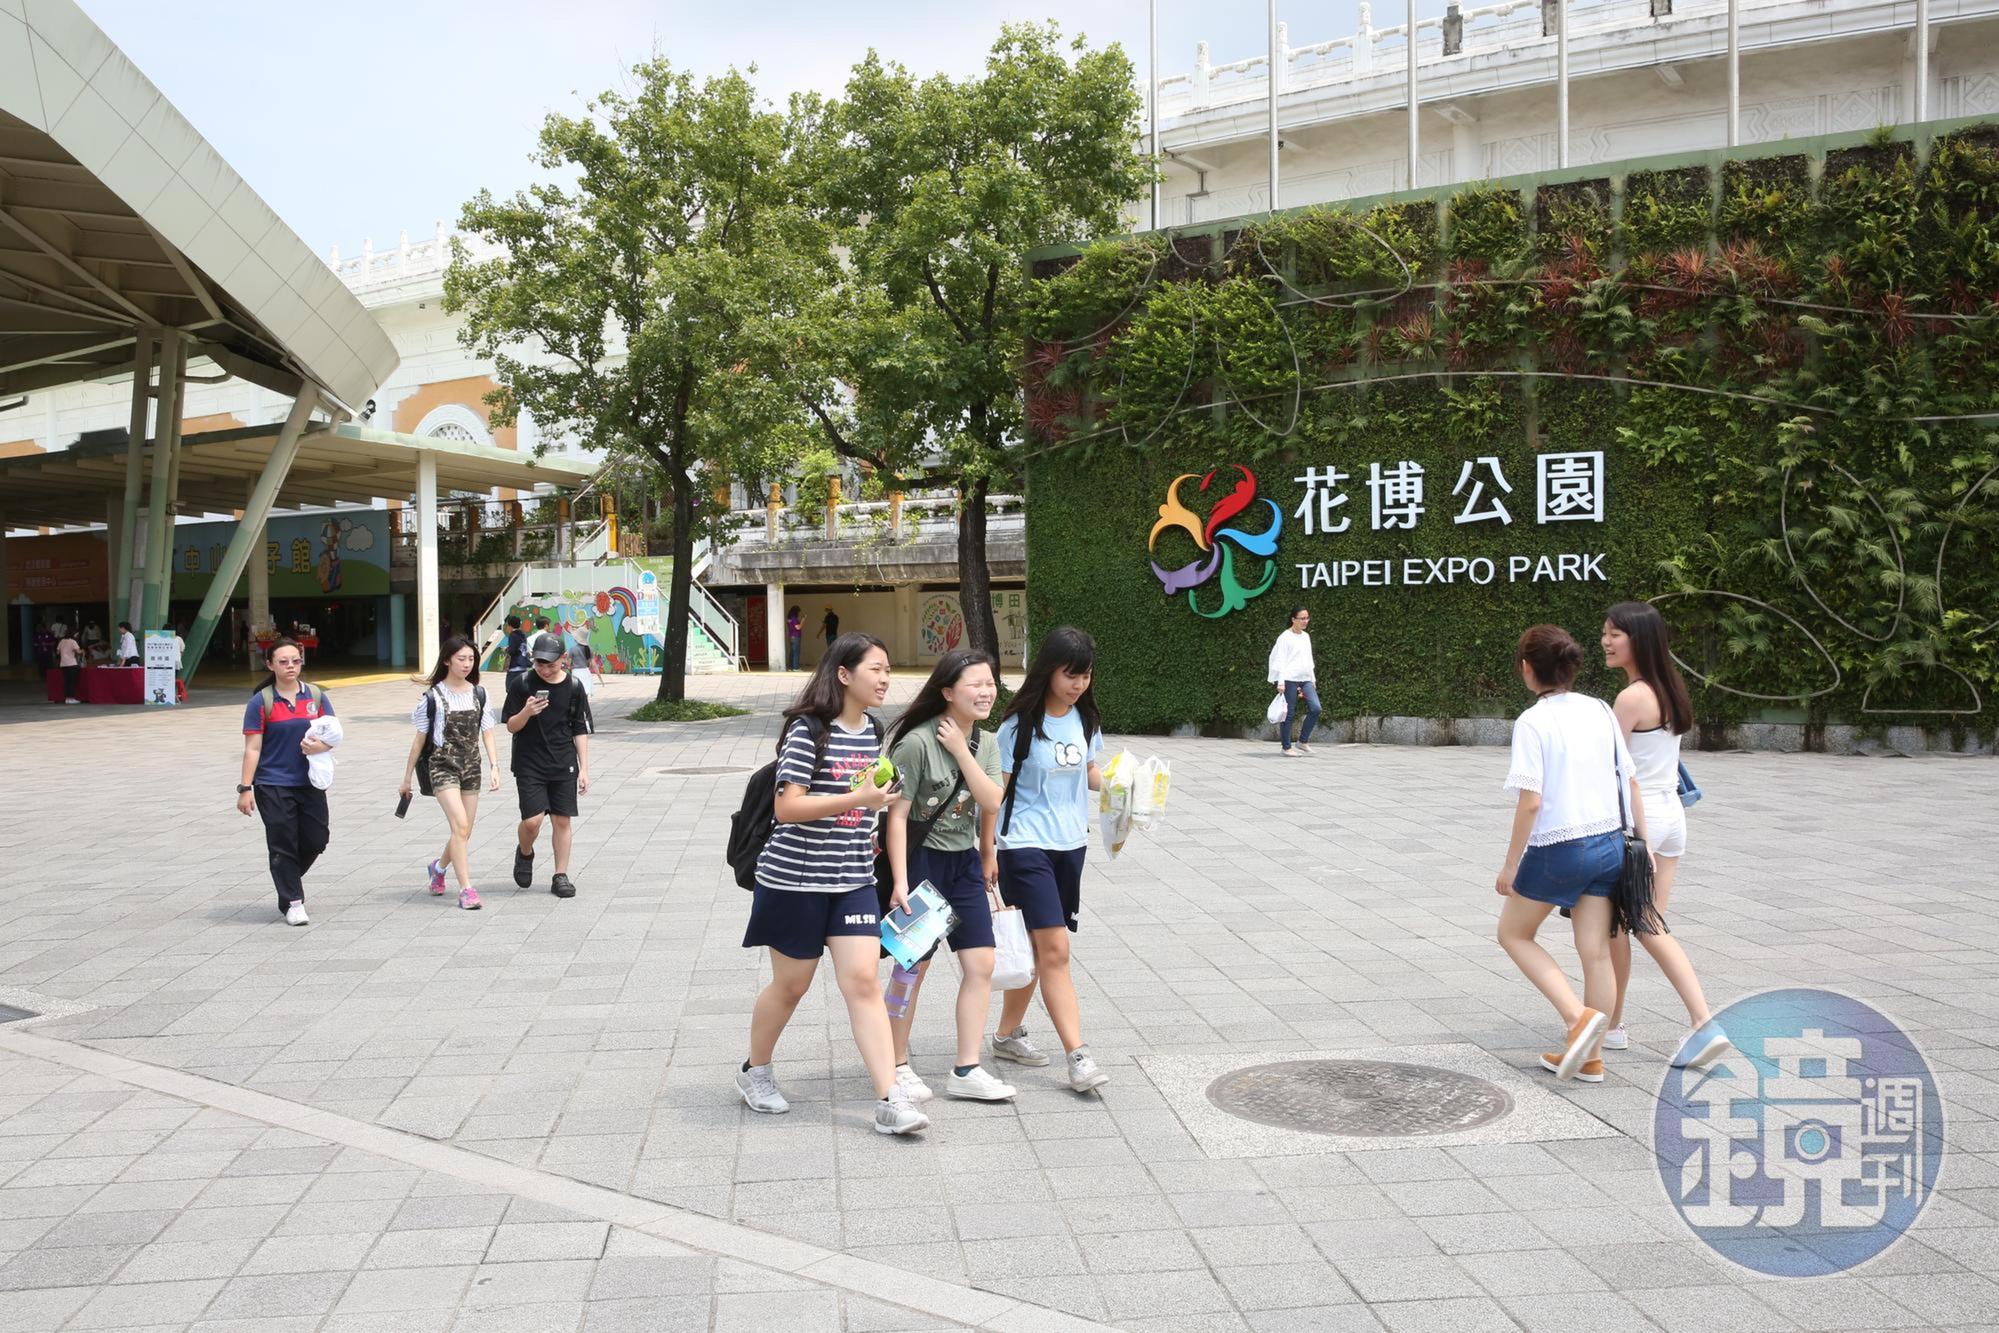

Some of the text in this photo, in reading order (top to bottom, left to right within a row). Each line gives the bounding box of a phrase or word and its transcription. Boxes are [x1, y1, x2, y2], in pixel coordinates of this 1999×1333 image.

[1294, 451, 1604, 535] 花博公園
[184, 538, 312, 578] 中山子館
[1295, 553, 1607, 589] TAIPEI EXPO PARK
[844, 914, 876, 924] MLSH
